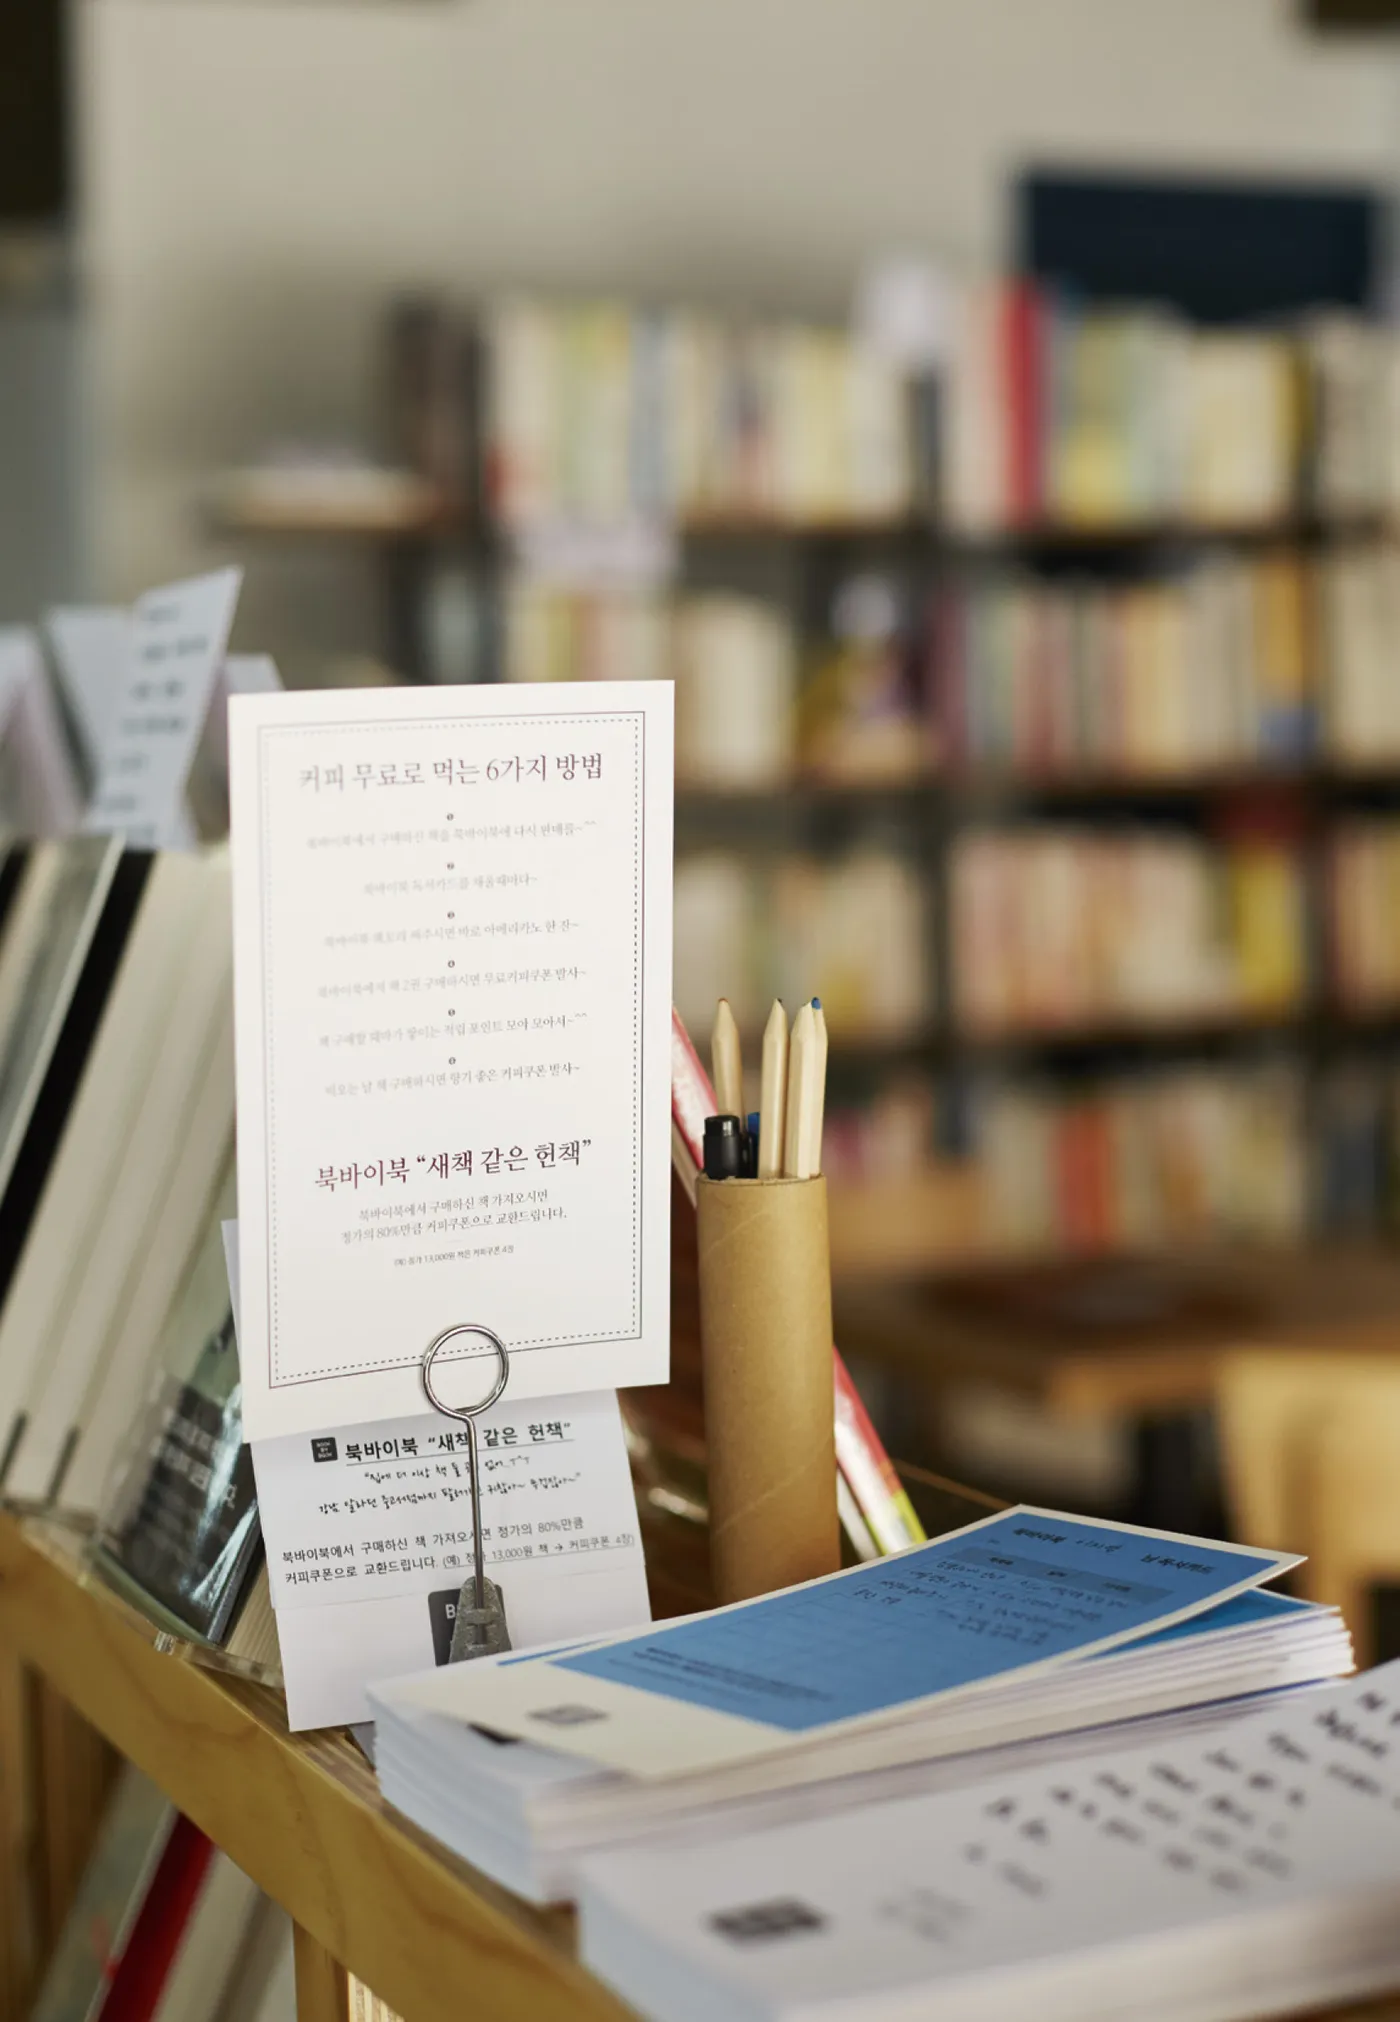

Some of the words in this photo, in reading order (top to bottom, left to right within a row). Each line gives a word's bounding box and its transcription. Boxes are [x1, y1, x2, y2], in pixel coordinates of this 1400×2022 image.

[299, 763, 344, 793] 커피
[352, 762, 426, 791] 무료로
[433, 757, 481, 786] 먹는
[486, 754, 547, 783] 6가지
[555, 752, 602, 780] 방법
[484, 921, 543, 936] 아메리카노
[470, 1019, 503, 1034] 포인트
[506, 1017, 529, 1031] 모아
[315, 1156, 411, 1192] 북바이북
[416, 1149, 473, 1180] “새책
[480, 1145, 529, 1174] 같은
[534, 1139, 592, 1169] 헌책”
[341, 1227, 375, 1245] 정가의
[376, 1222, 423, 1240] 80%만큼
[427, 1214, 494, 1233] 커피쿠폰으로
[496, 1206, 568, 1225] 교환드립니다.
[359, 1201, 427, 1222] 북바이북에서
[430, 1196, 475, 1213] 구매하신
[479, 1195, 489, 1208] 책
[345, 1436, 419, 1462] 북바이북
[483, 1426, 519, 1447] 같은
[528, 1422, 571, 1439] 헌책”
[396, 1470, 407, 1479] 더
[412, 1467, 430, 1479] 이상
[435, 1464, 447, 1477] 책
[319, 1502, 340, 1514] 강남
[381, 1491, 437, 1510] 중고서점까지
[282, 1544, 356, 1565] 북바이북에서
[361, 1537, 408, 1555] 구매하신
[415, 1535, 427, 1548] 책
[497, 1522, 534, 1539] 정가의
[537, 1516, 584, 1533] 80%만큼
[285, 1566, 358, 1585] 커피쿠폰으로
[364, 1555, 439, 1576] 교환드립니다.
[443, 1554, 461, 1568] (예)
[491, 1545, 534, 1561] 13,000원
[538, 1543, 549, 1555] 책
[568, 1535, 611, 1550] 커피쿠폰
[615, 1533, 636, 1548] 4장)
